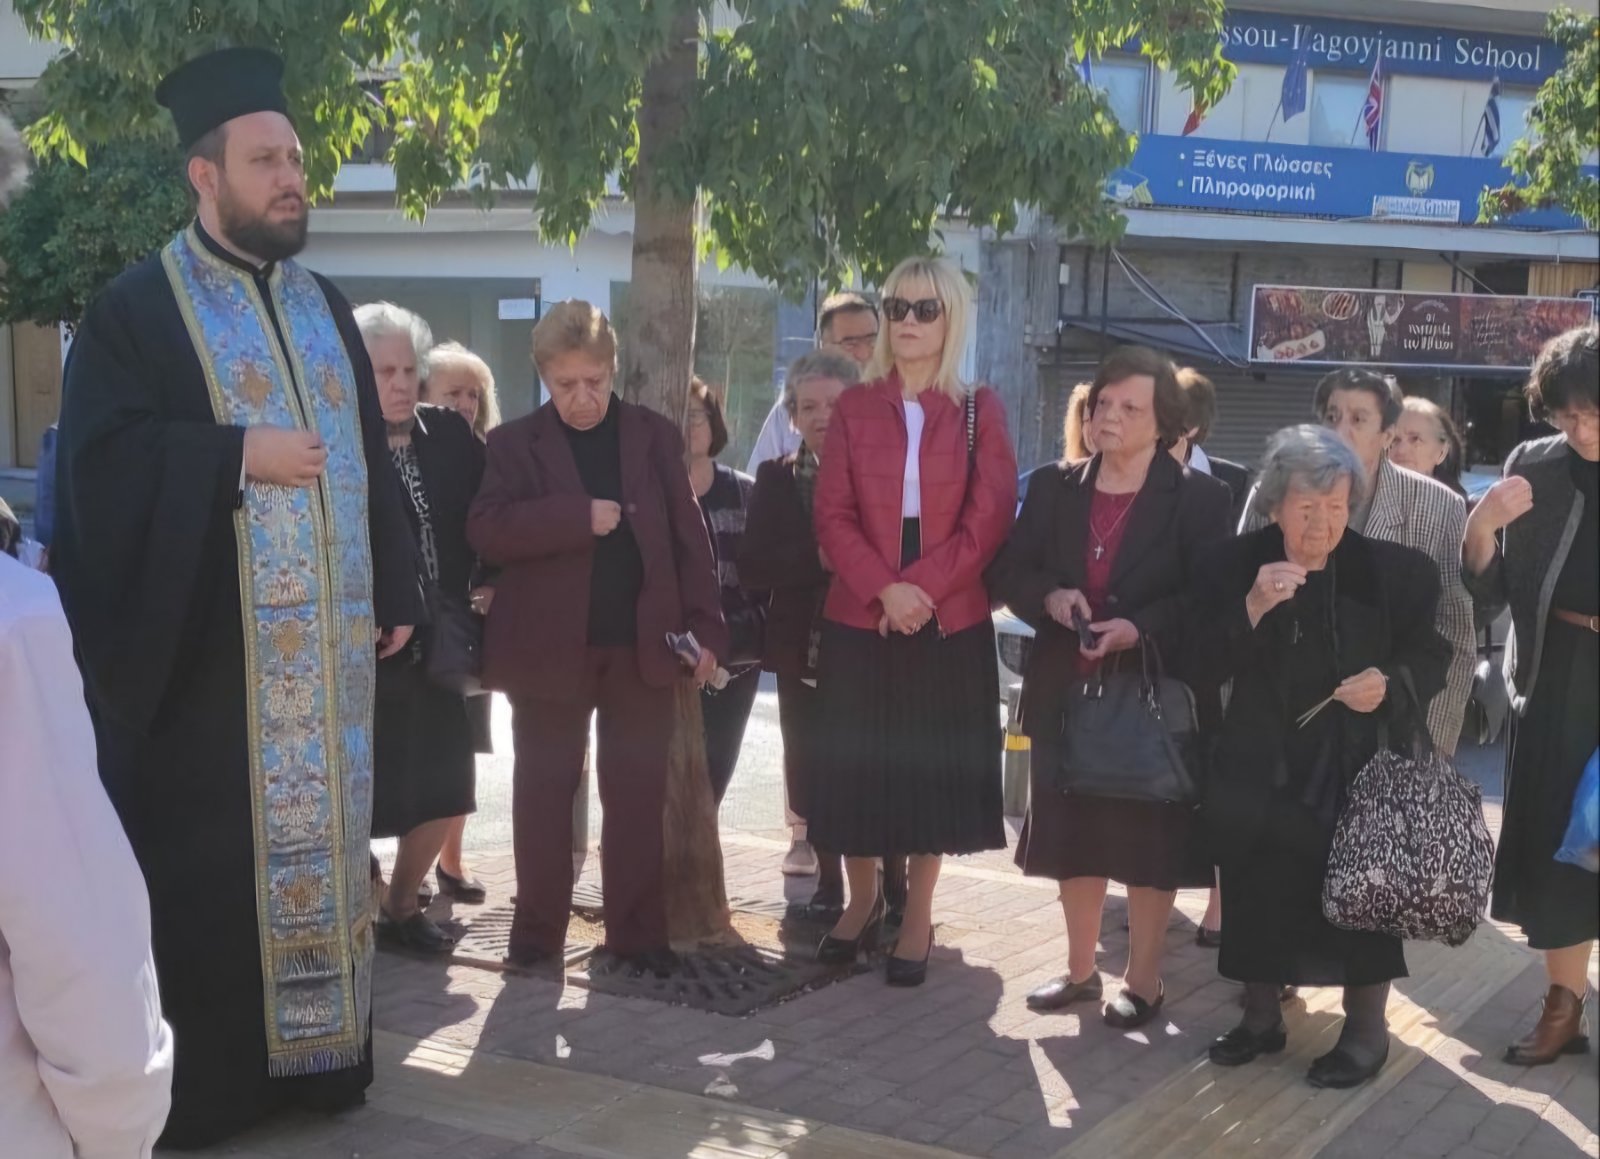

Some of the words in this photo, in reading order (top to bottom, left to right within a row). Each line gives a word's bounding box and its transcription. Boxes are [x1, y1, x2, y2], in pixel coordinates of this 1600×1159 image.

[1454, 37, 1540, 71] School
[1193, 150, 1247, 173] Ξένες
[1253, 153, 1333, 179] Γλώσσες
[1191, 176, 1315, 201] Πληροφορική
